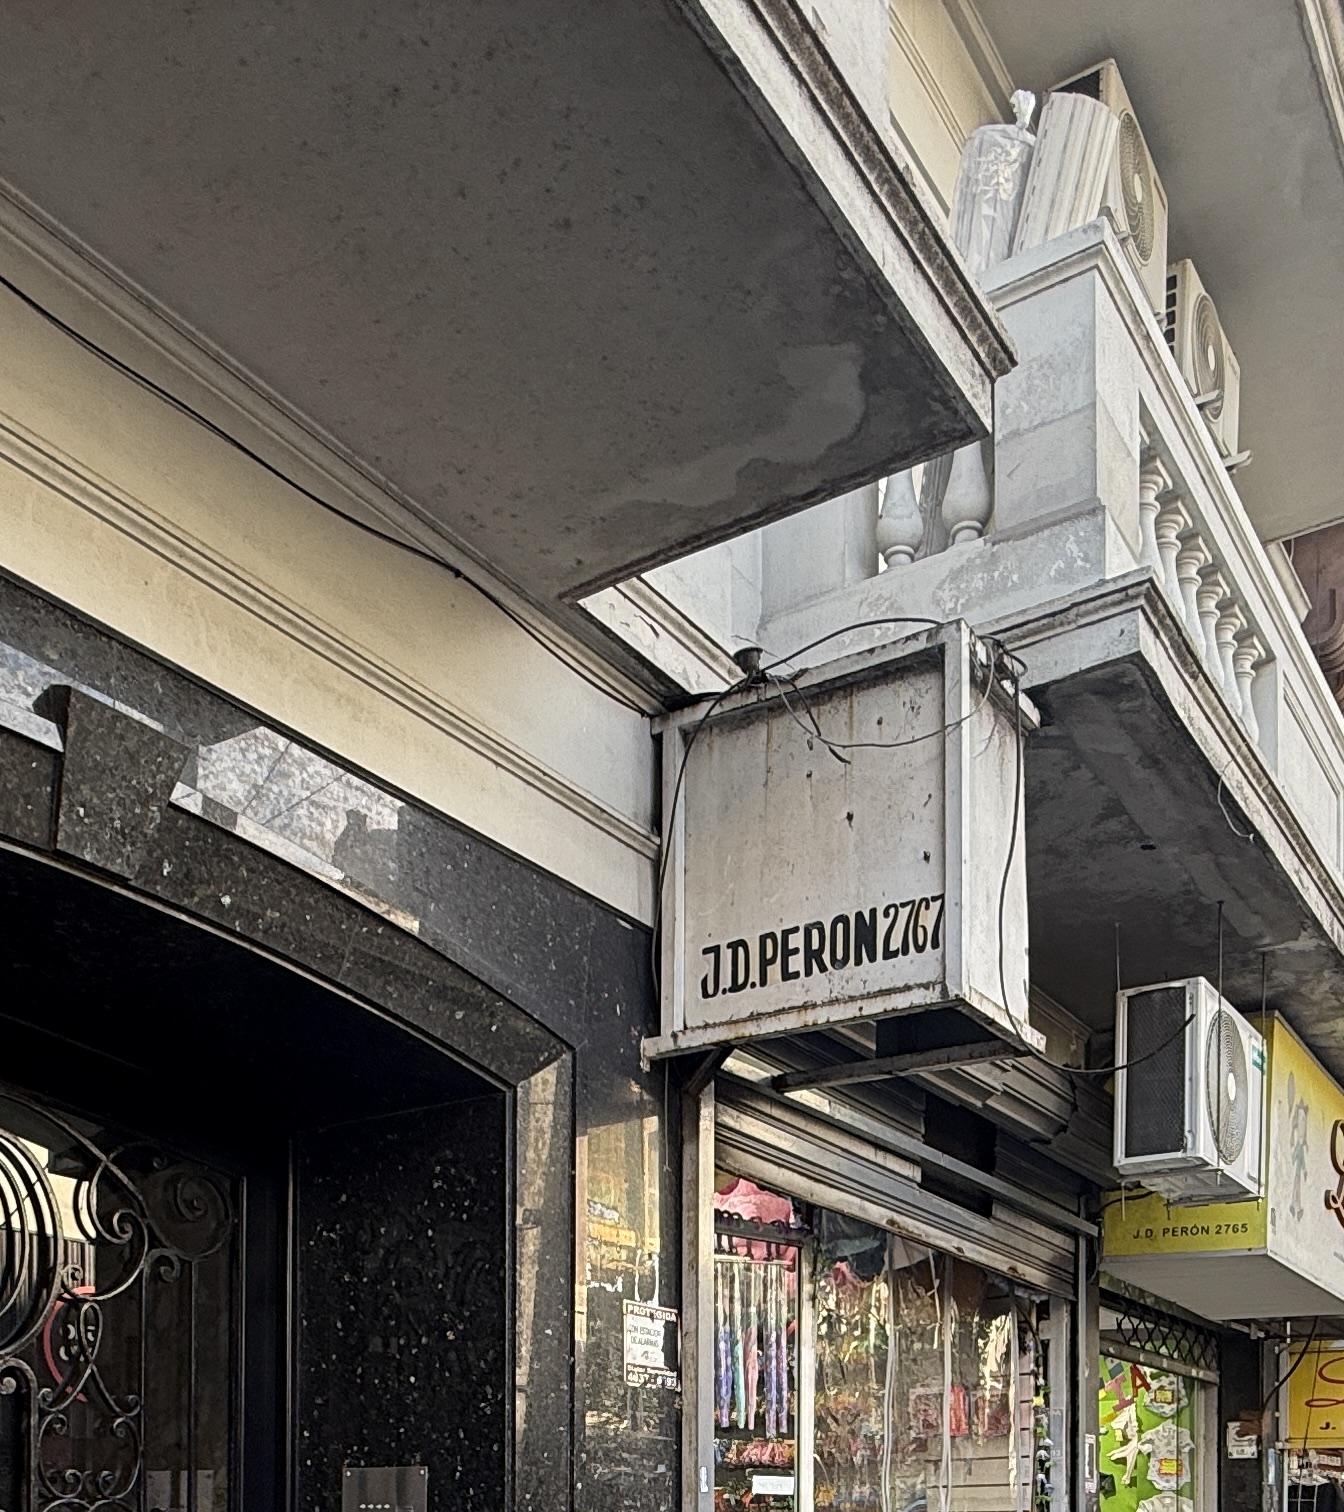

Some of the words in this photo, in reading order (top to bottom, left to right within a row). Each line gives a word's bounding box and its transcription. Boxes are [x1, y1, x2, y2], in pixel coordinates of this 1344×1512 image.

[882, 894, 945, 961] 2767
[1162, 1224, 1210, 1237] PERÓN
[1215, 1223, 1248, 1235] 2765
[1319, 1421, 1336, 1430] J.
